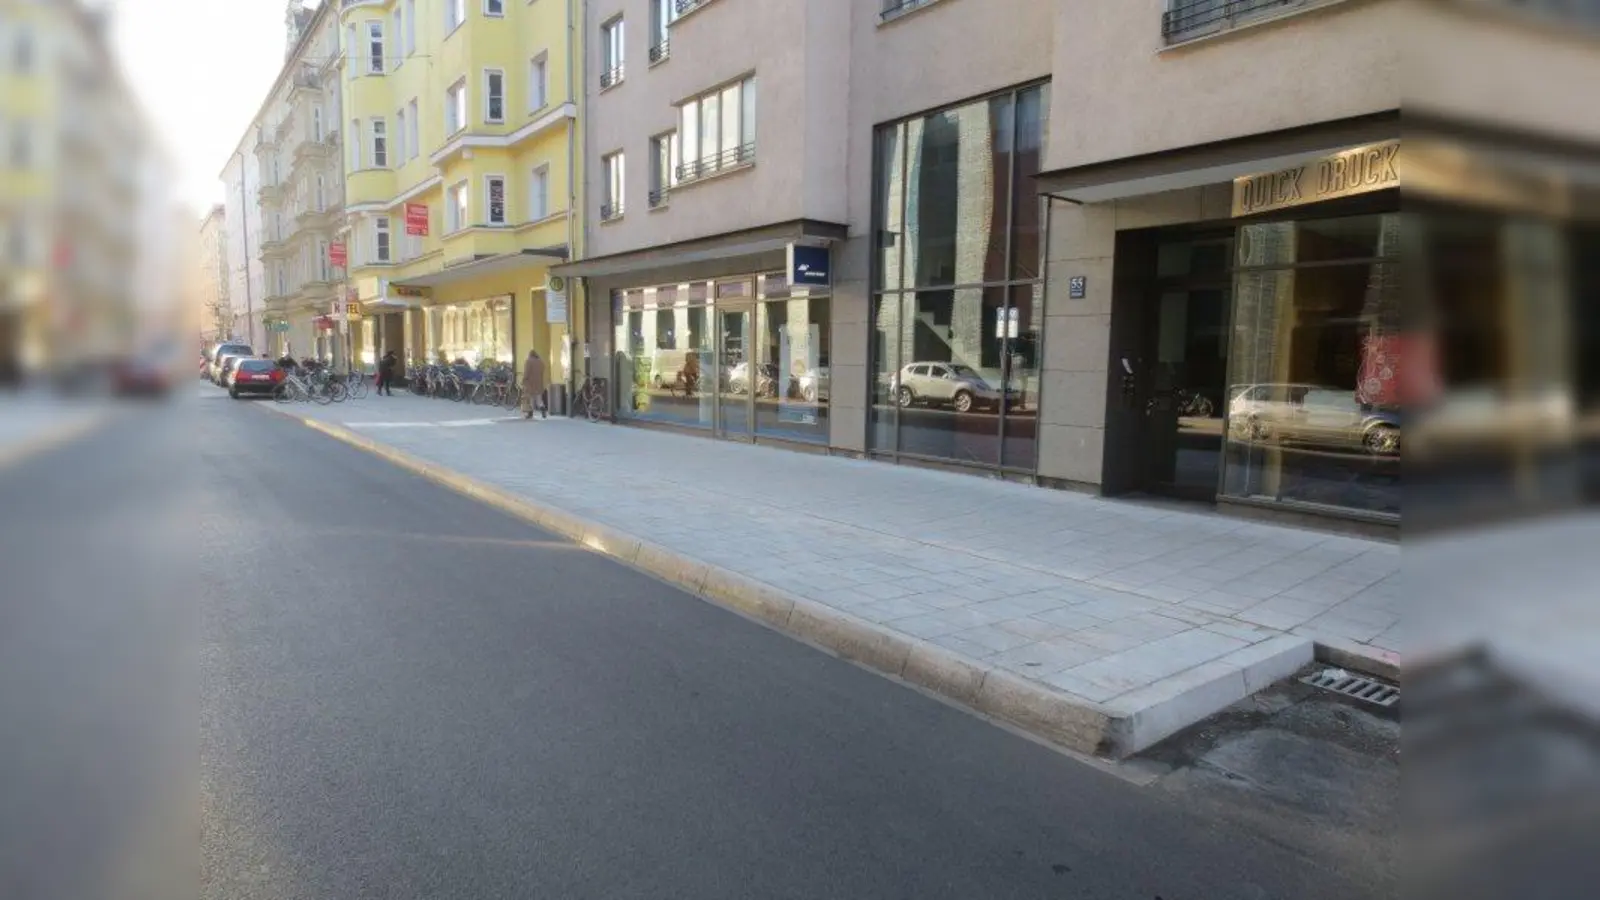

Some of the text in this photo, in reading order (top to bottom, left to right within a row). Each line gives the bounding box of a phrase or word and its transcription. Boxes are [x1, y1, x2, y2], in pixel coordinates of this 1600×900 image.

[1241, 143, 1400, 212] QUICK DRUCK
[1071, 278, 1083, 289] 55
[334, 303, 359, 314] HTEL
